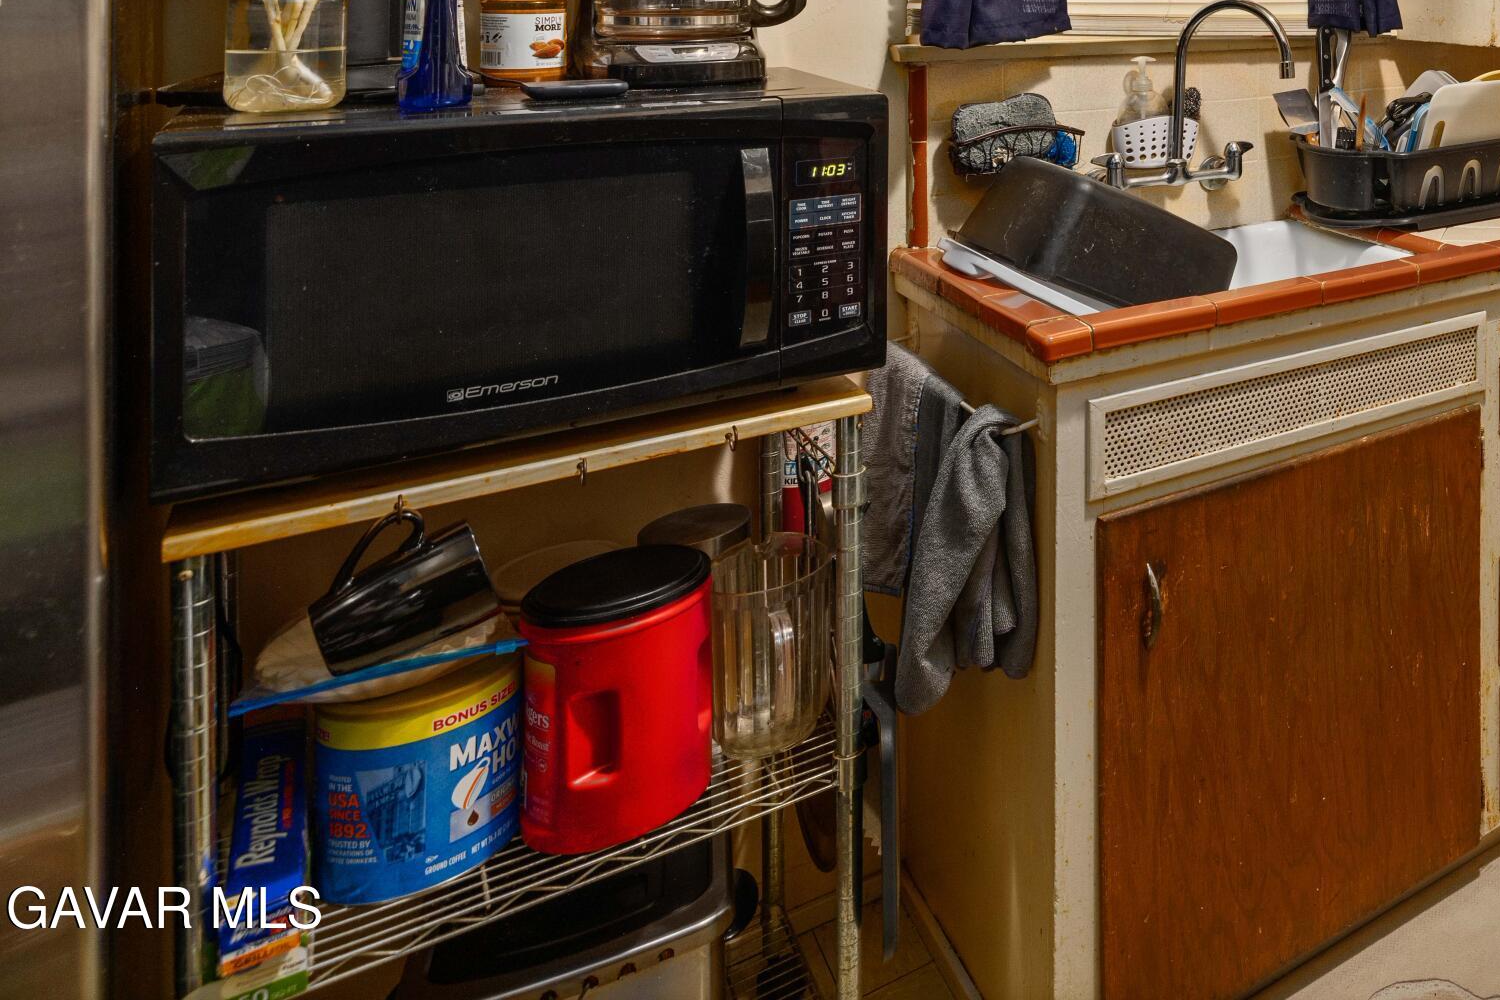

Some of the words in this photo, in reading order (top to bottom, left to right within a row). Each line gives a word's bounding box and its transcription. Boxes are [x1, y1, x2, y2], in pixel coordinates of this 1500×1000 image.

[534, 23, 562, 32] MORE
[535, 15, 563, 25] SIMPLY
[811, 163, 846, 178] 11:03
[821, 265, 829, 273] 2
[847, 261, 854, 270] 3
[796, 281, 803, 289] 4
[821, 277, 829, 286] 5
[846, 274, 854, 282] 6
[796, 294, 803, 303] 7
[821, 291, 829, 299] 8
[846, 287, 854, 296] 9
[821, 308, 829, 317] 0
[841, 304, 858, 312] START
[465, 375, 559, 399] Emerson
[432, 700, 488, 733] BONUS
[489, 680, 517, 707] SIZE!
[449, 711, 519, 772] MAXW
[242, 753, 292, 799] Wrap
[337, 784, 353, 792] THE
[328, 792, 361, 808] USA
[234, 790, 289, 870] Reynolds
[358, 840, 372, 849] BY
[424, 859, 449, 876] GROUND
[448, 850, 467, 866] COFFEE
